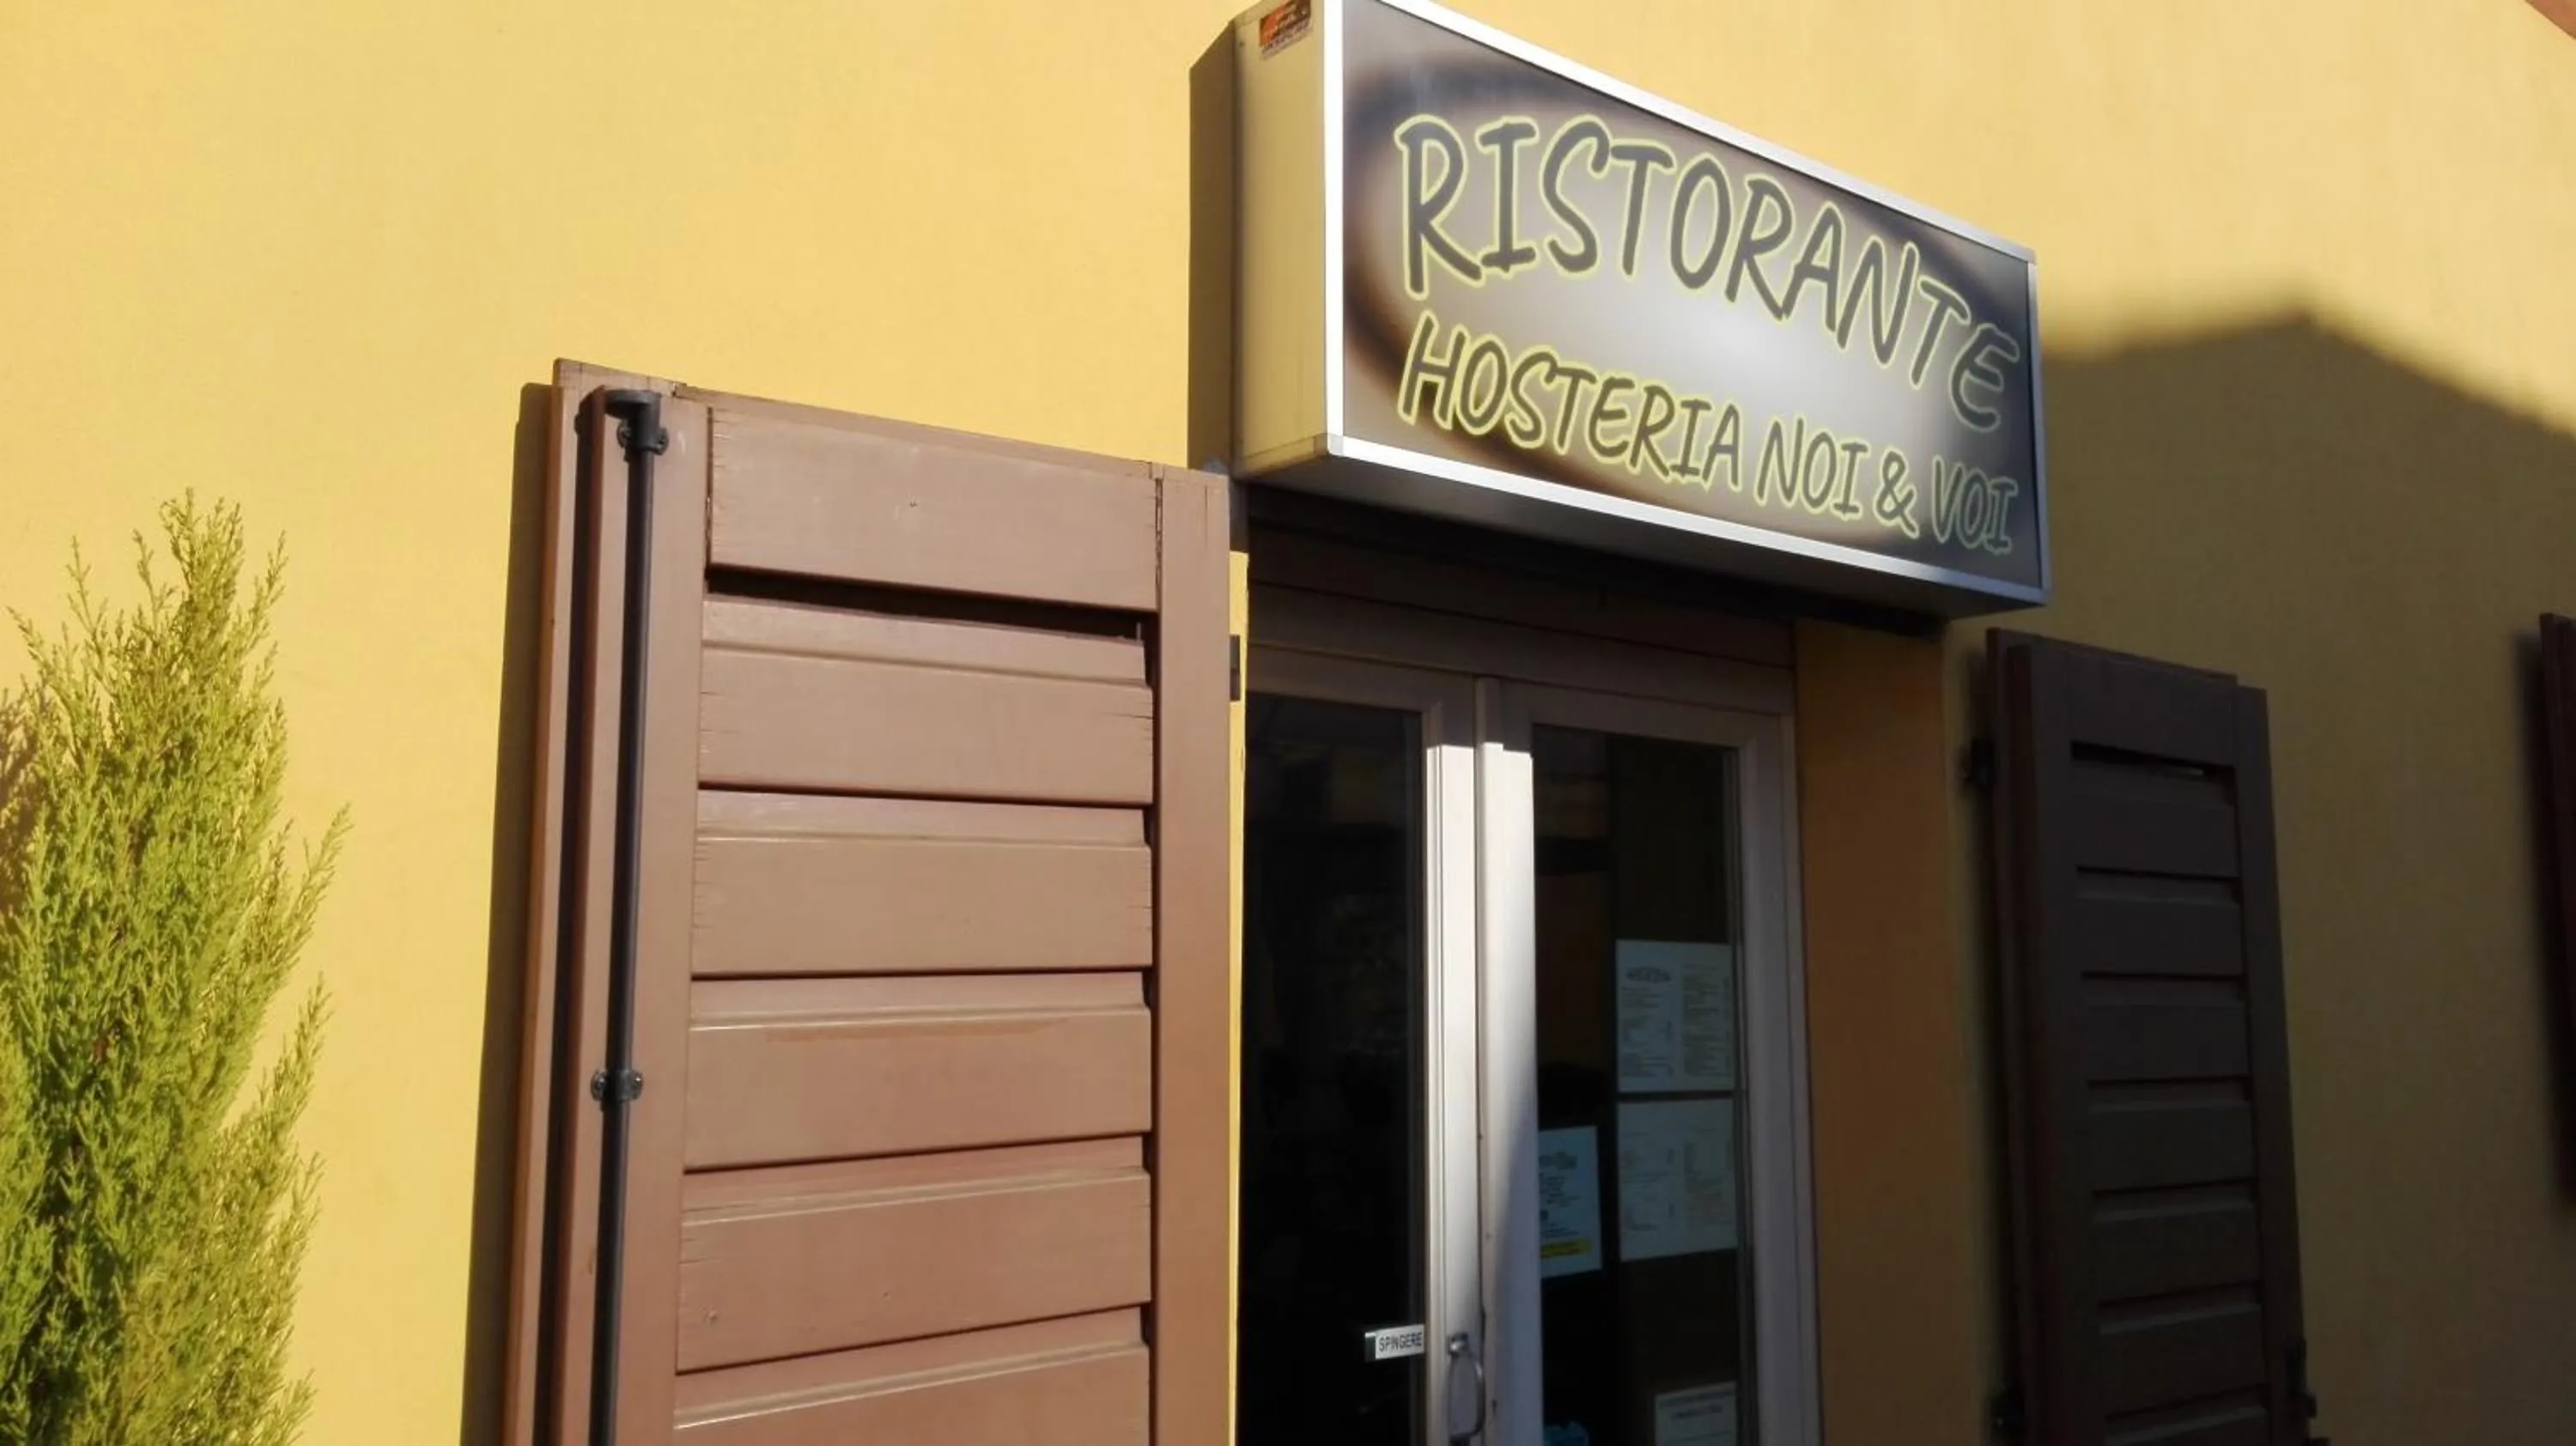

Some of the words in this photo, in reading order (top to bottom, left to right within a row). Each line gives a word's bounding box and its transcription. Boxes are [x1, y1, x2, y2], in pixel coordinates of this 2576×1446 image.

[1394, 114, 2020, 433] RISTORANTE
[1400, 311, 1741, 488] HOSTERIA
[1758, 416, 1870, 520] NOI
[1874, 451, 1919, 538] &
[1931, 456, 2018, 555] VOI
[1379, 1331, 1423, 1352] SPINGERE
